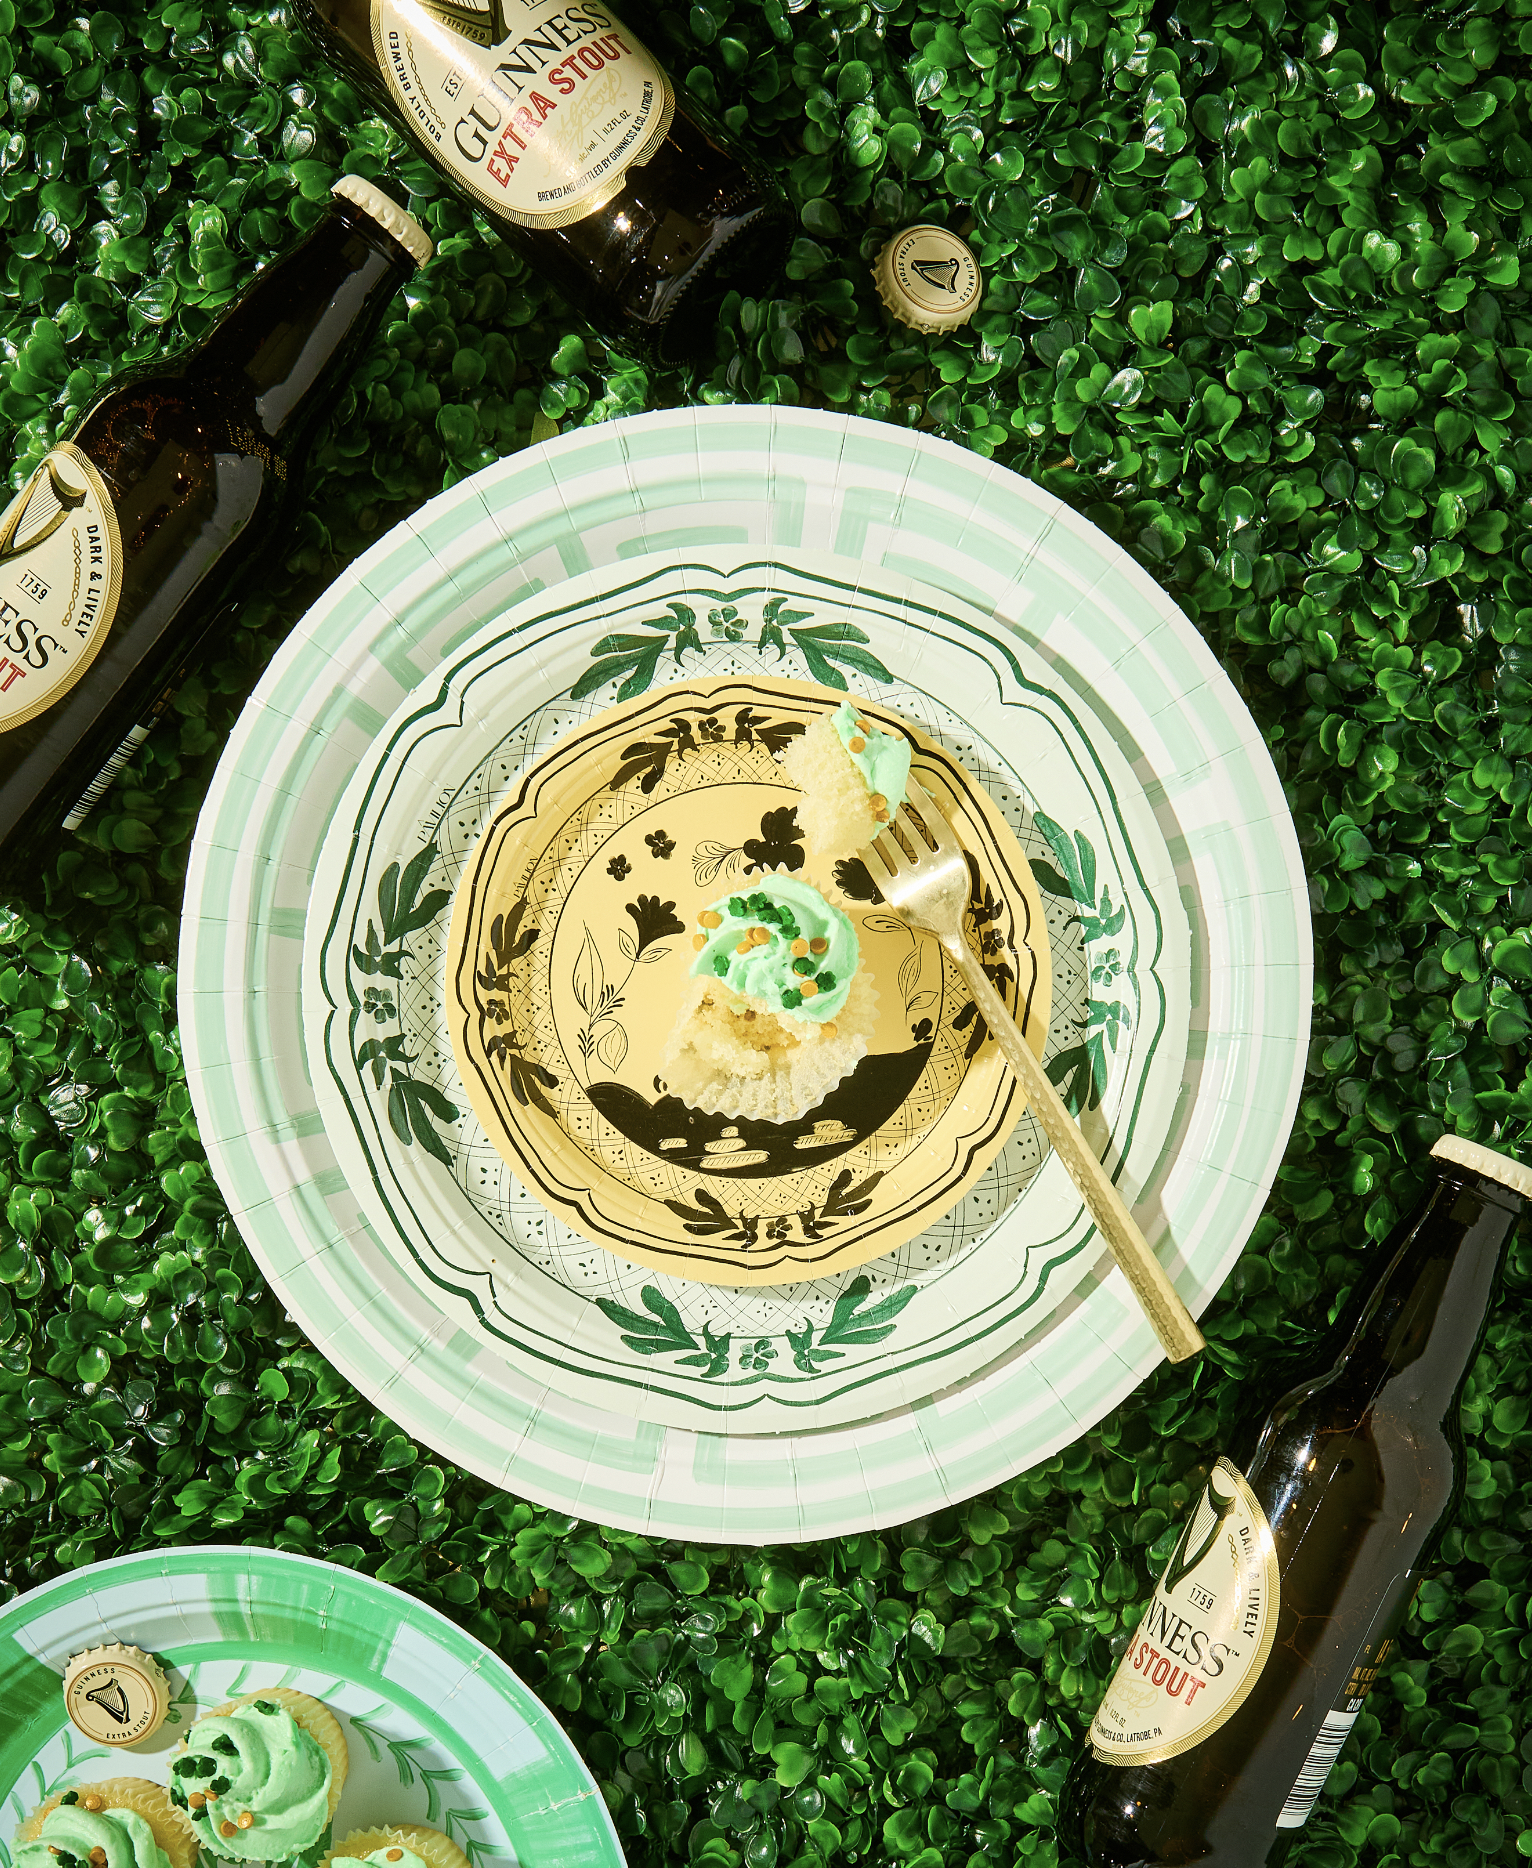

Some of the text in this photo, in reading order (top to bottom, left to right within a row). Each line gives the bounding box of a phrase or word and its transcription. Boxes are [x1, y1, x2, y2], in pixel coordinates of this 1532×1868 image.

[388, 31, 442, 142] BOLDLY BREWED
[486, 91, 558, 189] EXTRA
[548, 33, 632, 95] STOUT
[537, 187, 563, 202] BREWED
[563, 182, 577, 196] AND
[575, 164, 604, 190] BOTTLED
[601, 156, 613, 170] BY
[608, 129, 638, 162] GUINNESS
[631, 124, 642, 133] &
[898, 238, 916, 287] EXTRA STOUT
[959, 256, 975, 302] GUINNESS
[20, 573, 48, 600] 1759
[74, 524, 103, 638] DARK & LIVELY
[1190, 1587, 1214, 1610] 1759
[1239, 1526, 1260, 1638] DARK & LIVELY
[74, 1667, 116, 1695] GUINNESS
[1133, 1642, 1207, 1706] STOUT
[106, 1710, 150, 1740] EXTRA STOUT
[1153, 1727, 1162, 1737] PA
